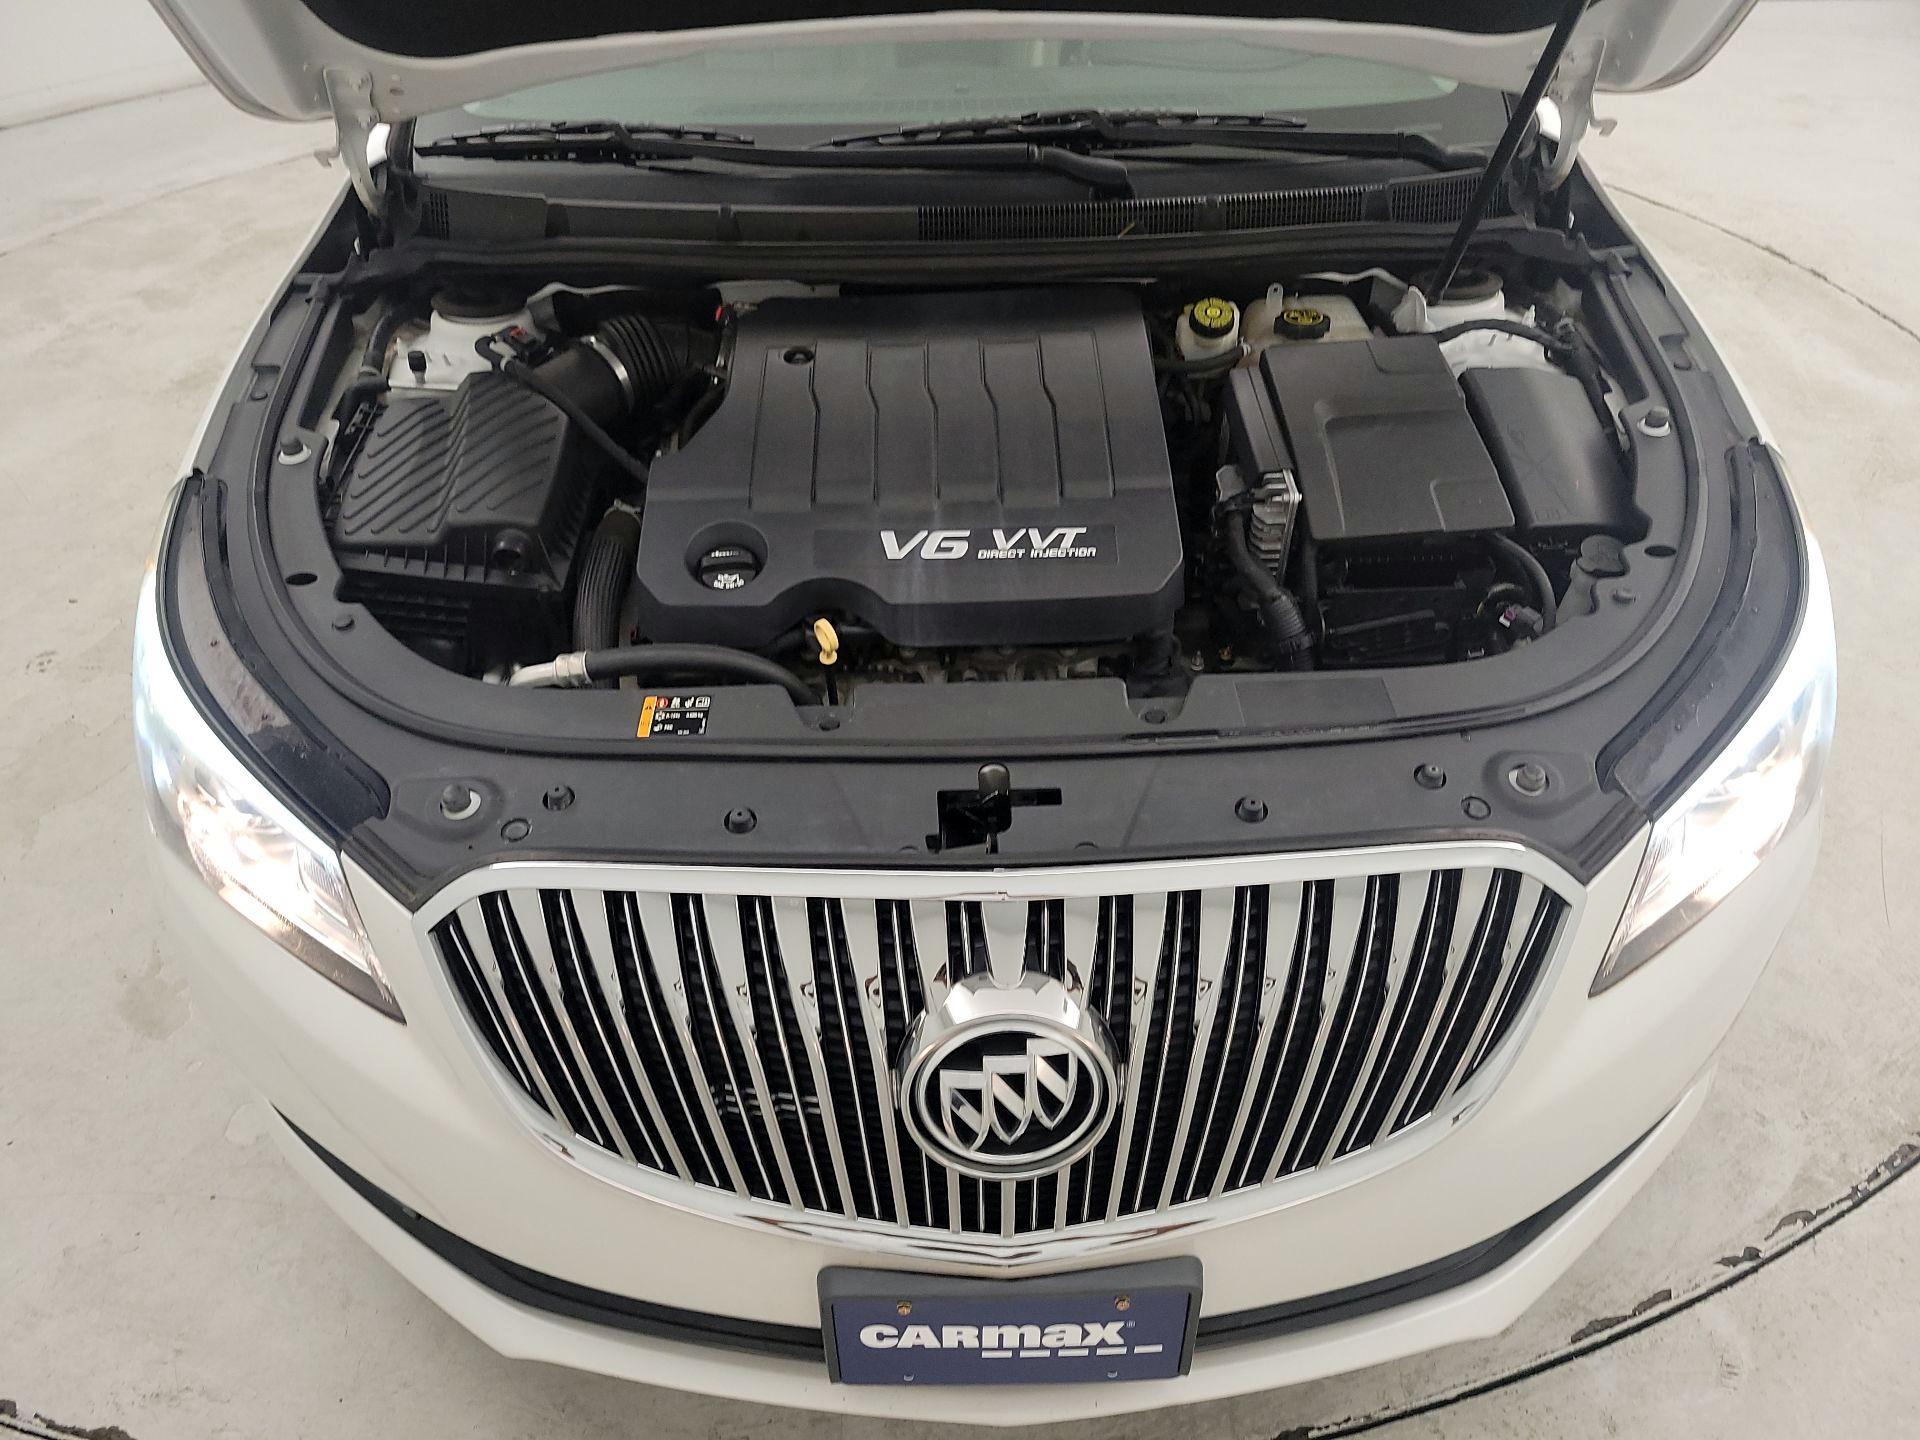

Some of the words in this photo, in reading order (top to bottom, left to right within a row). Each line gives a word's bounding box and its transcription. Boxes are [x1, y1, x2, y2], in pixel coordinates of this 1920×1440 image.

[880, 529, 971, 560] V6
[992, 526, 1088, 550] VVT
[977, 548, 1026, 560] DIRECT
[1030, 546, 1097, 559] INJECTION
